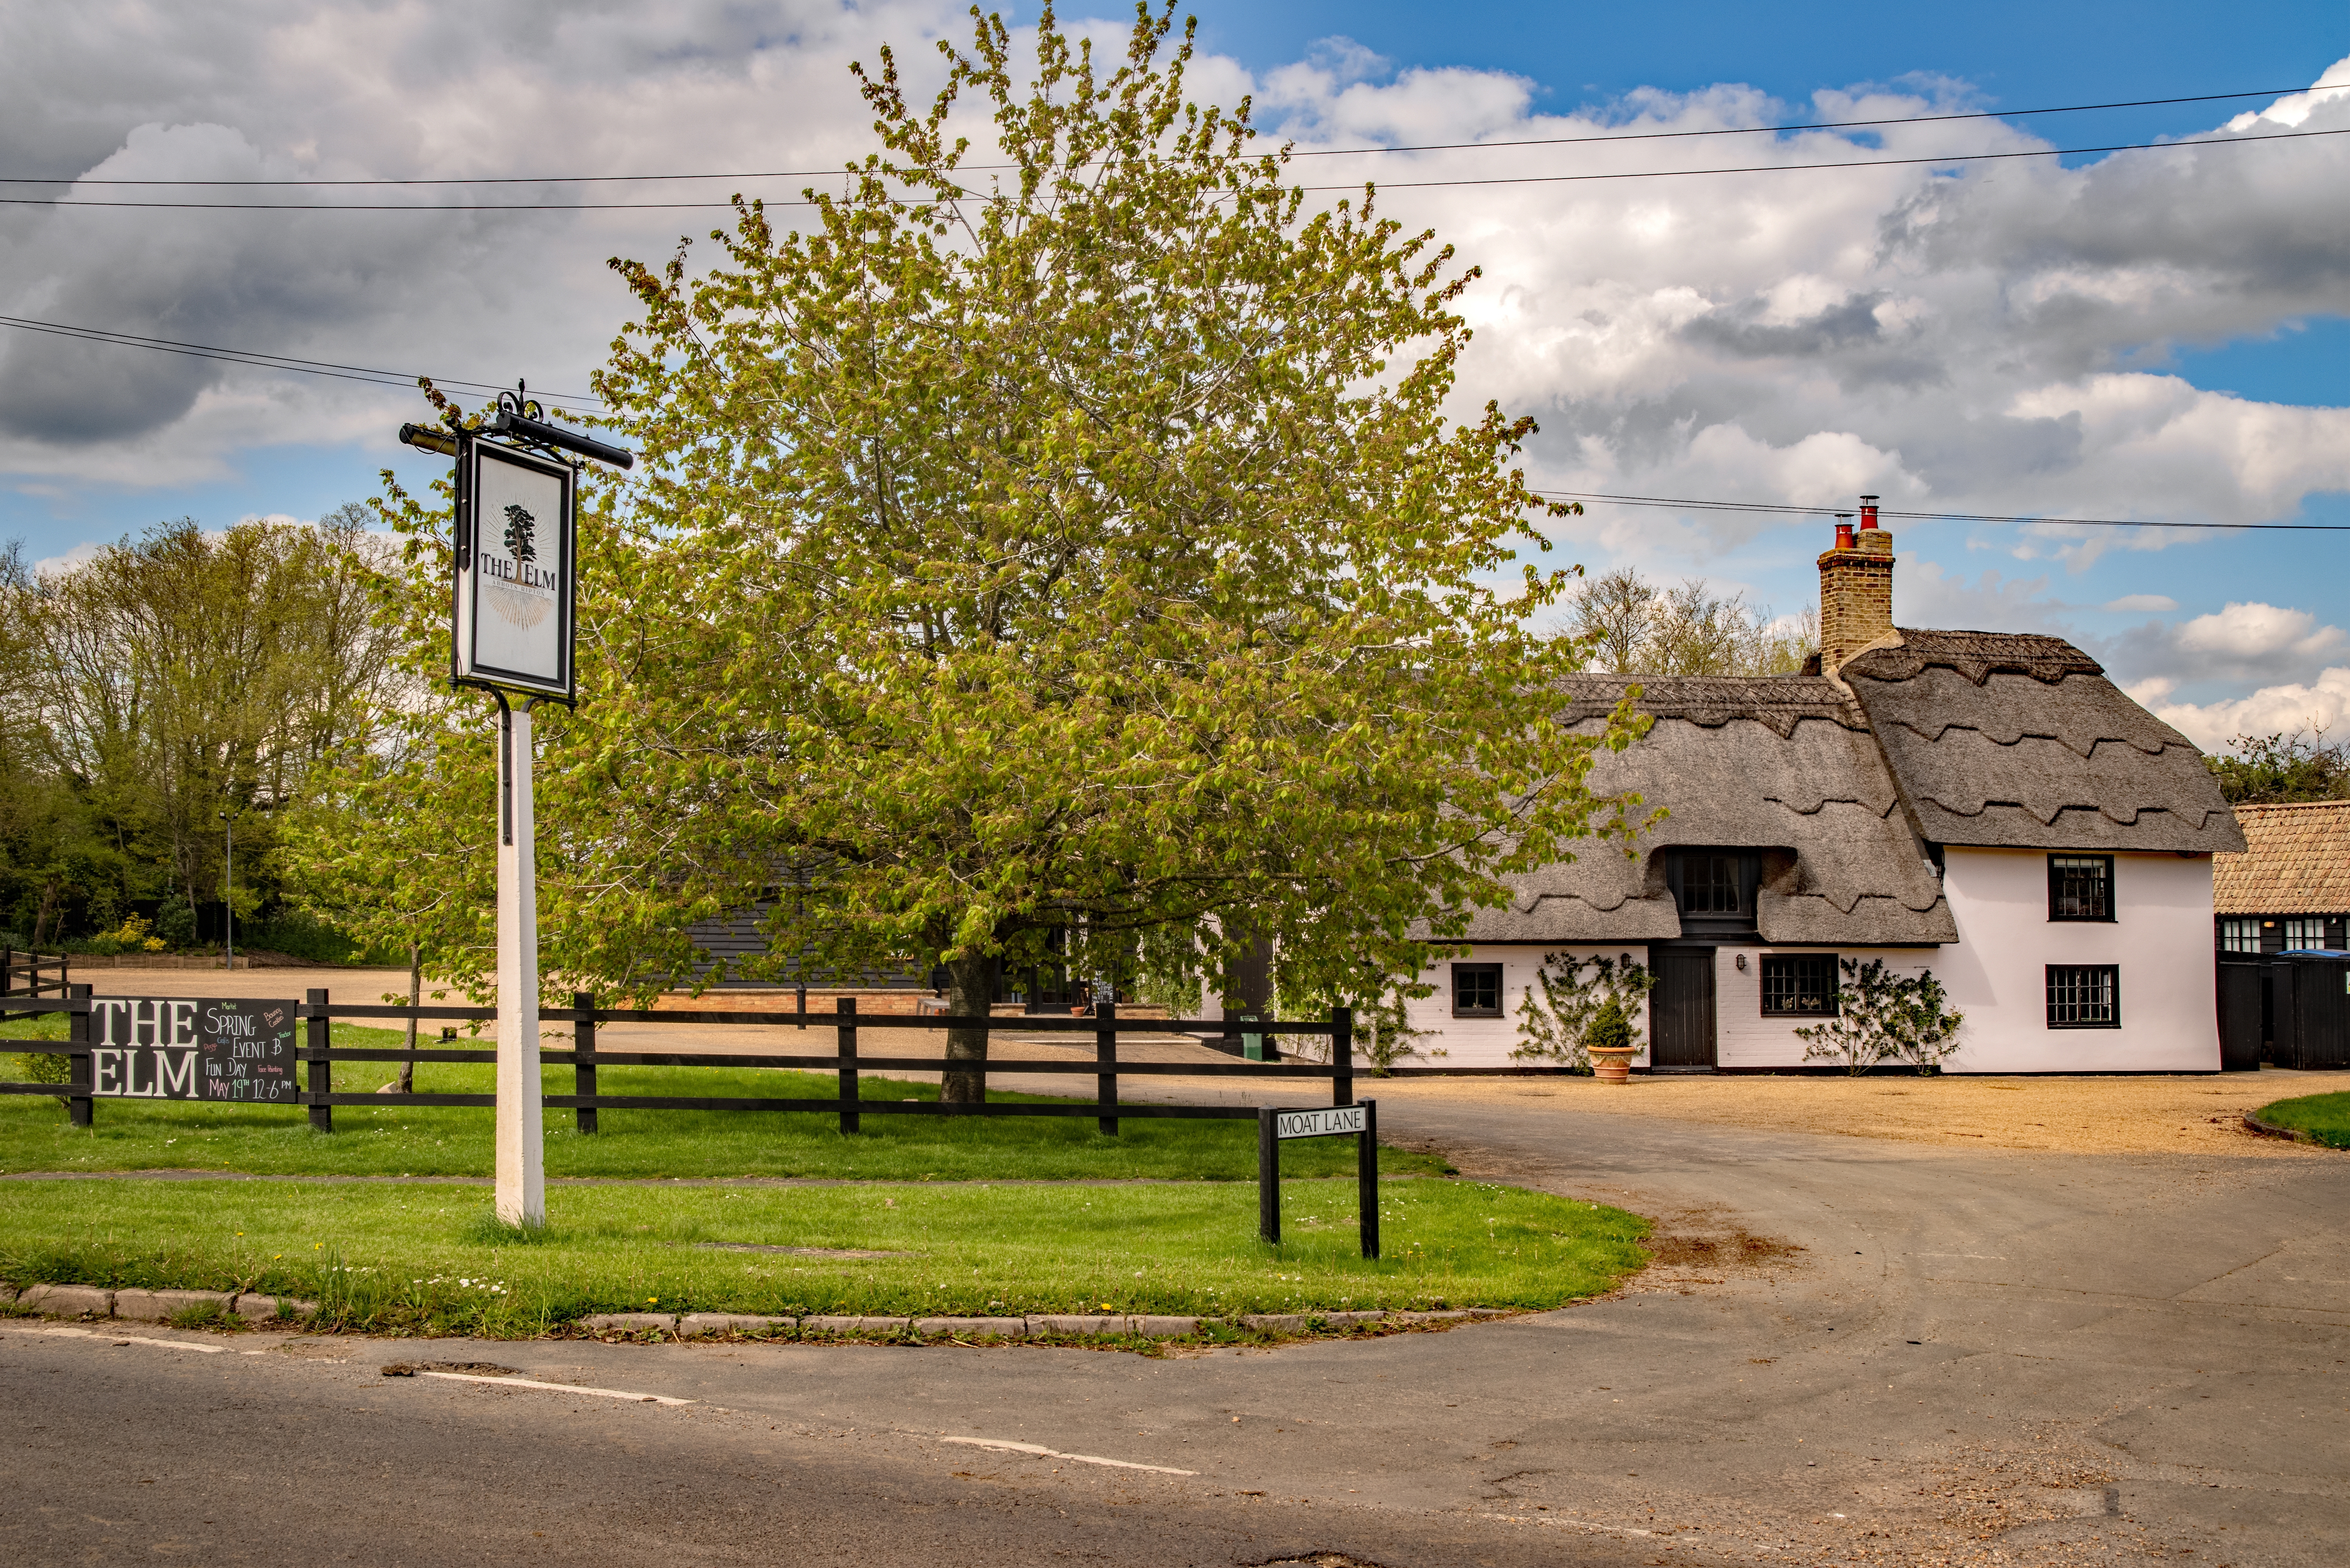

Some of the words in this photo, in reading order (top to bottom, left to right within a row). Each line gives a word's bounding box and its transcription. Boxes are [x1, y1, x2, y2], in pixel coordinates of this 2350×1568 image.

[481, 553, 513, 580] THE
[525, 564, 555, 591] ELM
[492, 580, 517, 590] ABBOTS
[521, 586, 544, 596] RIPTON
[91, 999, 197, 1047] THE
[204, 1008, 257, 1036] SPRING
[263, 1008, 283, 1021] Bouncy
[268, 1015, 284, 1028] Castles
[203, 1043, 217, 1052] Pizza
[233, 1037, 266, 1058] EVENT
[91, 1049, 199, 1098] ELM
[206, 1057, 222, 1076] FUN
[226, 1057, 247, 1078] DAY
[258, 1064, 266, 1073] Face
[268, 1065, 283, 1075] Painting
[209, 1078, 230, 1099] MAY
[253, 1078, 279, 1099] 12-6
[281, 1080, 291, 1089] PM
[1280, 1114, 1320, 1134] MOAT
[1325, 1111, 1361, 1131] LANE
